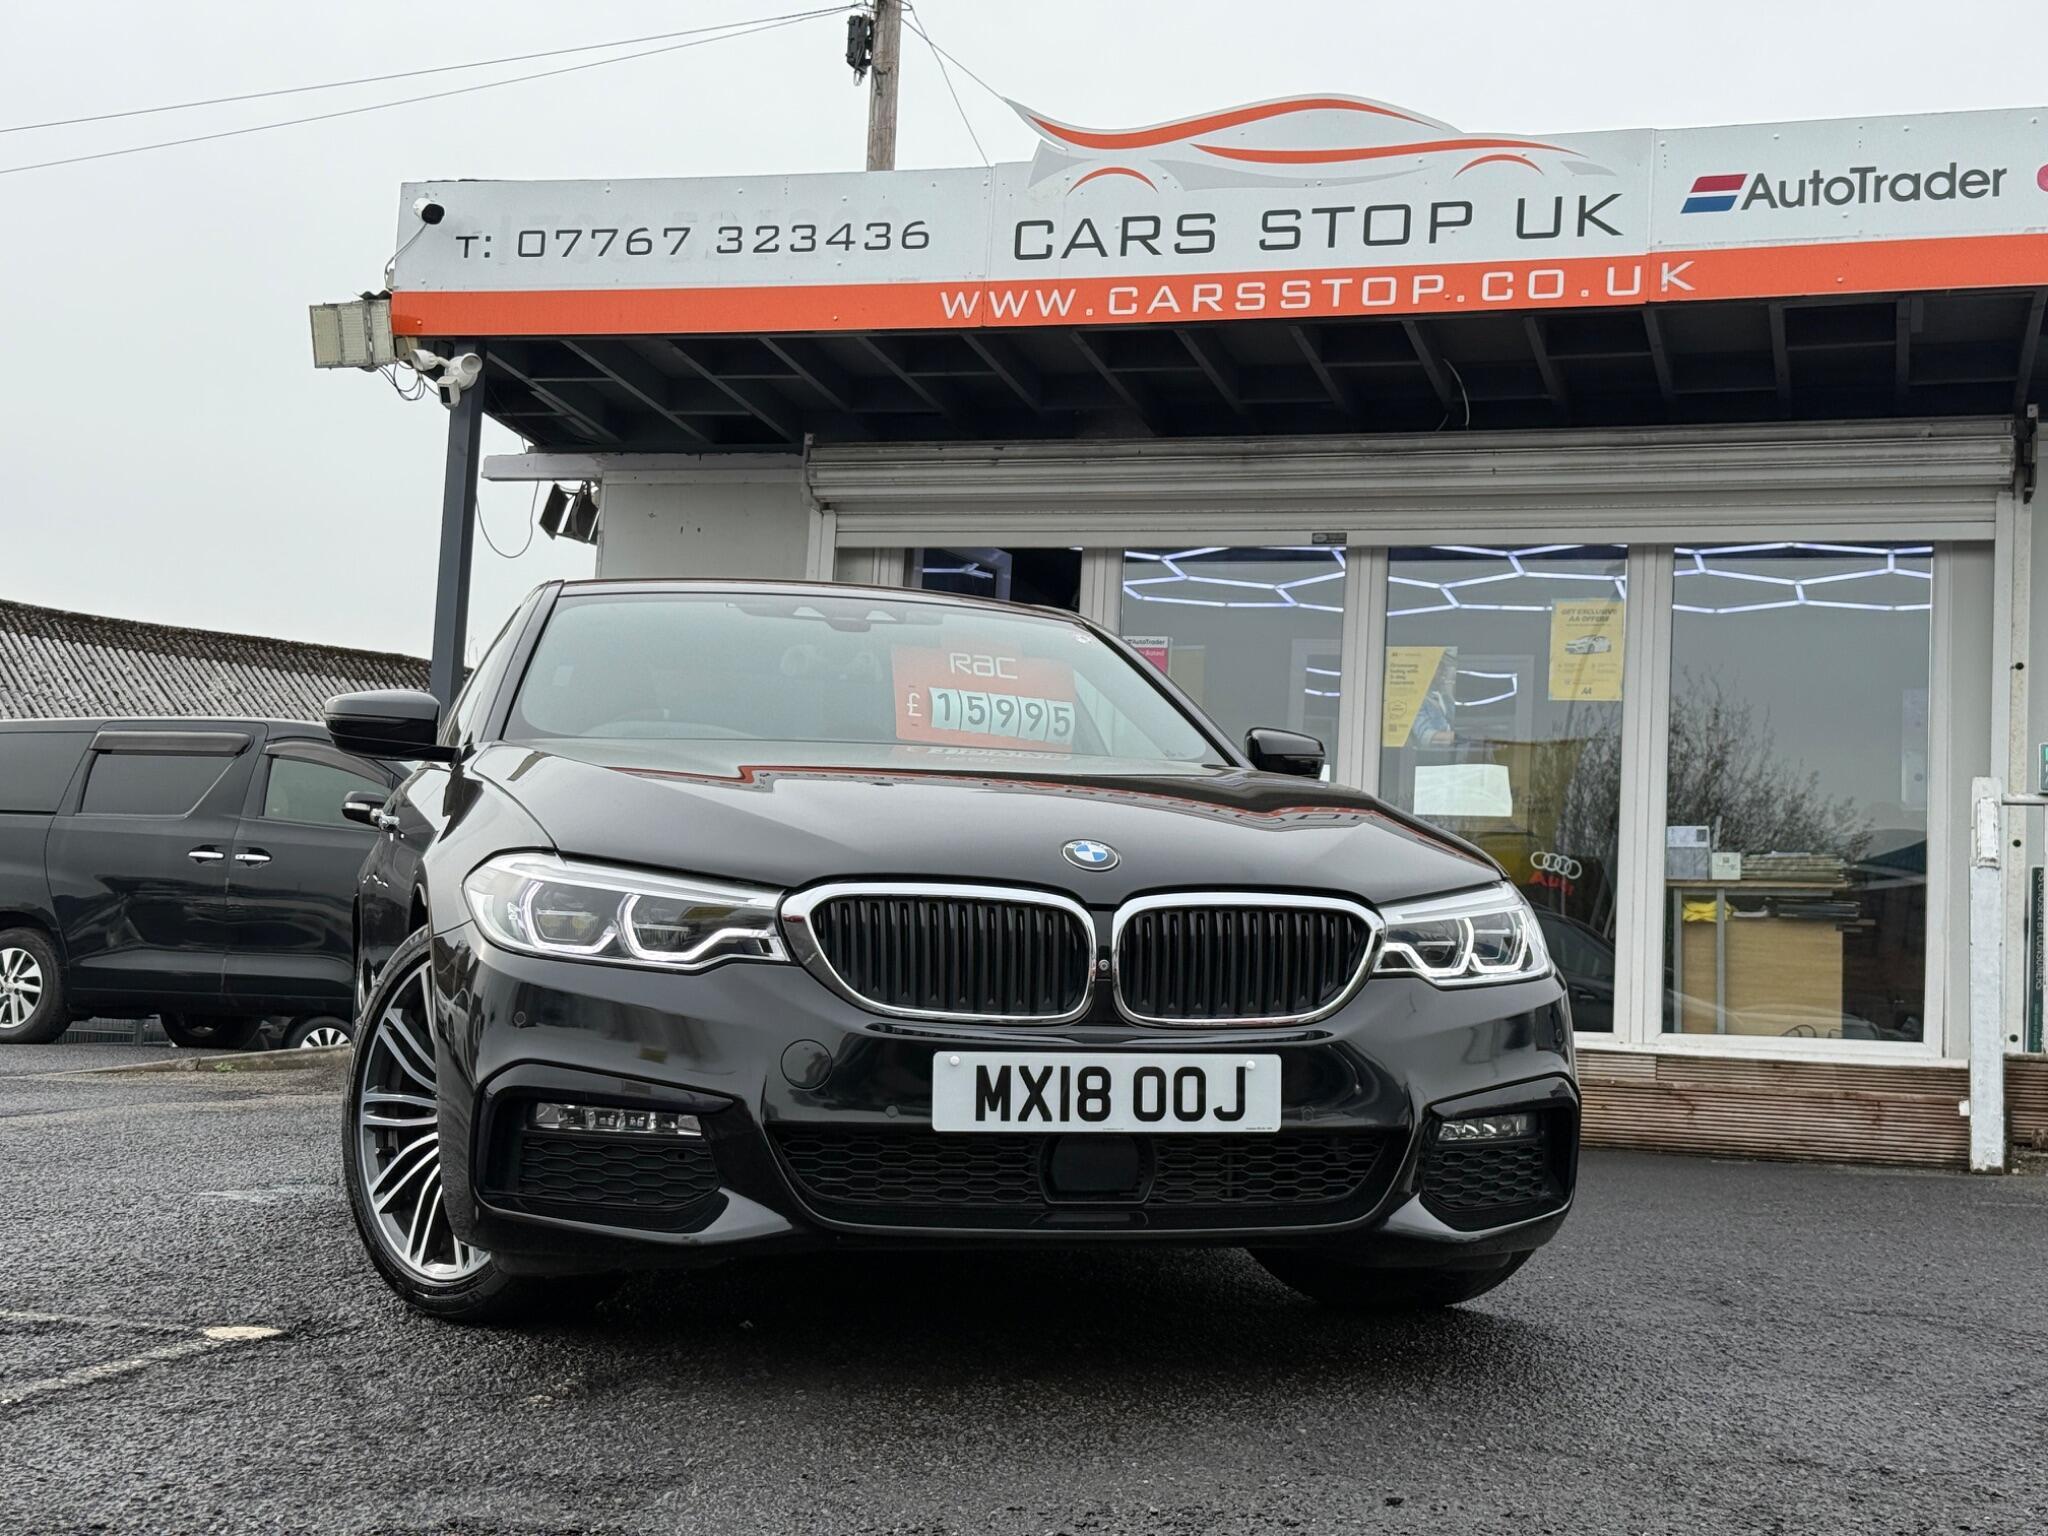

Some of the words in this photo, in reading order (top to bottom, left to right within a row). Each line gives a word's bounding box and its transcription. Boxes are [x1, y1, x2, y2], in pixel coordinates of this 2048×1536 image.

[1740, 162, 2008, 211] AutoTrader
[455, 235, 492, 259] T:
[517, 227, 691, 259] 07767
[716, 220, 932, 255] 323436
[1013, 211, 1217, 261] CARS
[1259, 200, 1475, 252] STOP
[1515, 193, 1625, 240] UK
[940, 260, 1696, 320] WWW.CARSSTOP.CO.UK
[906, 692, 923, 718] £
[936, 692, 1072, 738] 15995
[974, 1065, 1112, 1122] MX18
